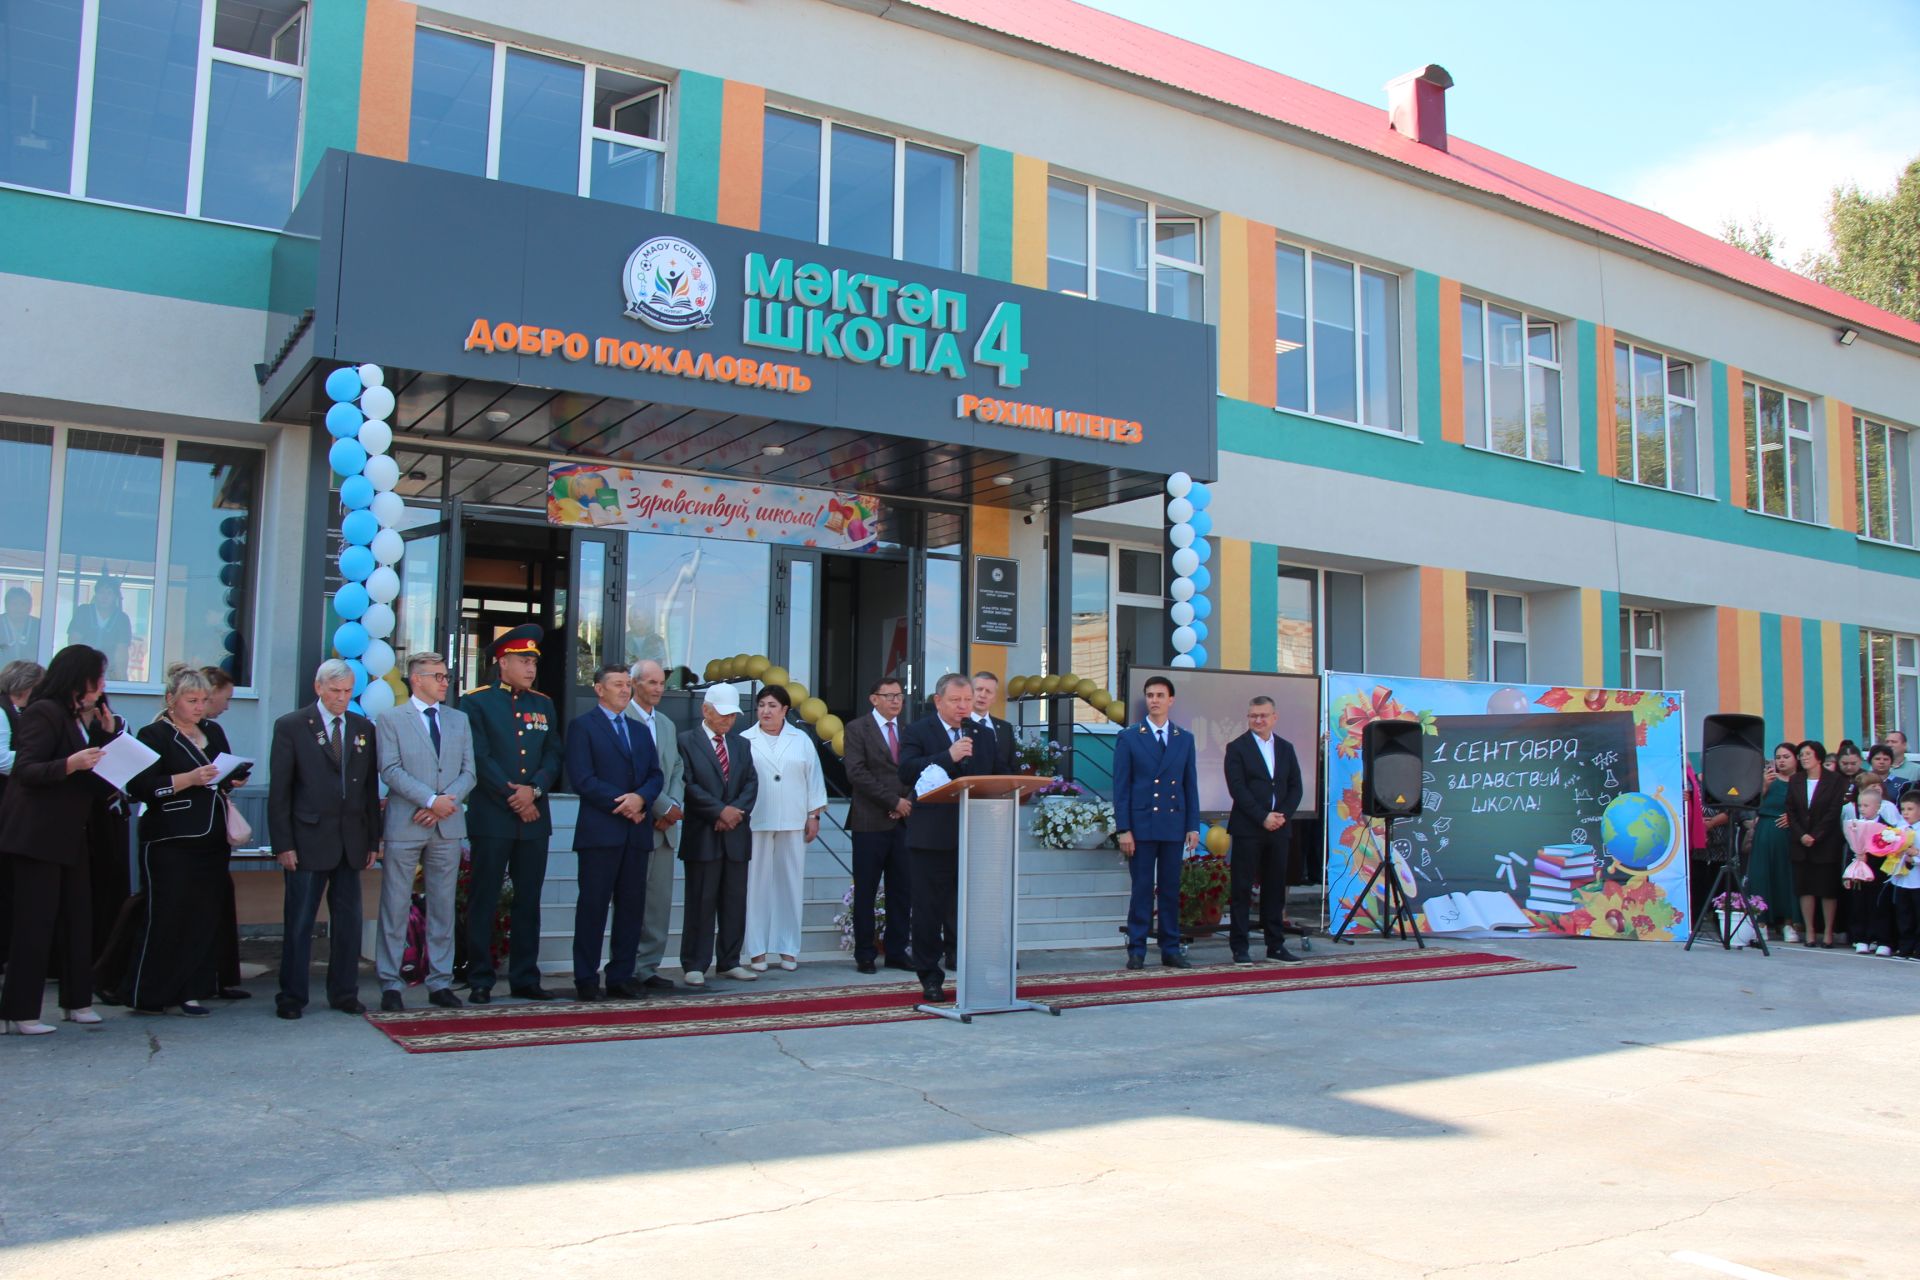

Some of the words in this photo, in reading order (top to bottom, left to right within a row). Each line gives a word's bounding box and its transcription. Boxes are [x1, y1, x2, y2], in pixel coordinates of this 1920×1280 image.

[642, 242, 670, 258] МАОУ
[673, 243, 697, 260] СОШ
[744, 252, 967, 333] МӘКТӘП
[465, 318, 589, 361] ДОБРО
[595, 336, 812, 395] ПОЖАЛОВАТЬ
[743, 298, 967, 379] ШКОЛА
[973, 302, 1029, 388] 4
[956, 394, 1053, 431] РӘХИМ
[1054, 409, 1144, 444] ИТЕГЕЗ
[627, 487, 750, 527] Здравствуй,
[755, 498, 824, 528] школа!
[1431, 742, 1447, 763] 1
[1453, 738, 1578, 762] СЕНТЯБРЯ
[1448, 767, 1560, 790] ЗДРАВСТВУЙ
[1471, 796, 1542, 813] ШКОЛА!
